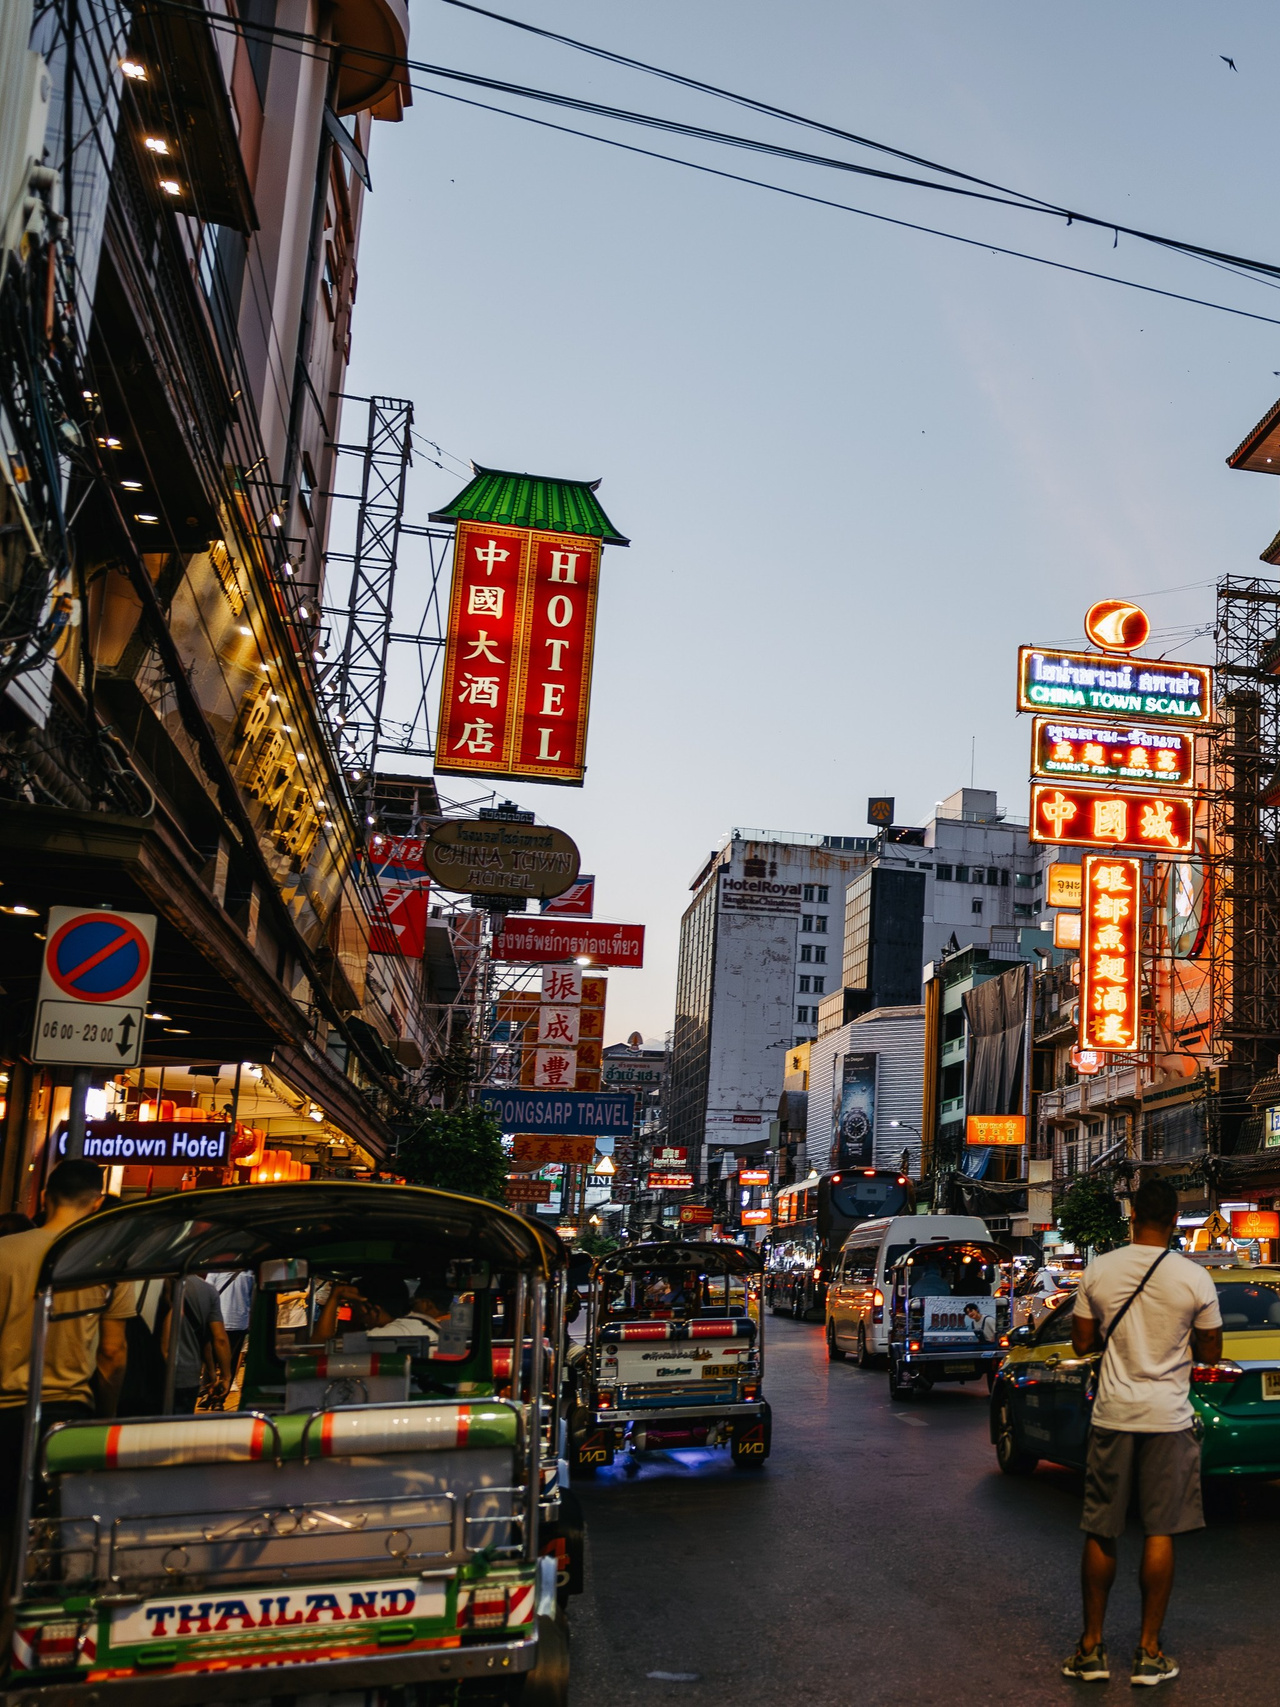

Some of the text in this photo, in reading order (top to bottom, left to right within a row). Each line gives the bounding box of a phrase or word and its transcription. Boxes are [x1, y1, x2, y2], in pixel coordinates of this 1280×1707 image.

[453, 540, 511, 754] 中國大酒店
[536, 551, 581, 761] HOTEL
[1030, 685, 1202, 717] CHINA TOWN SCALA
[1155, 771, 1181, 780] NEST
[1042, 791, 1179, 847] 中國城
[433, 844, 505, 868] CHINA
[512, 850, 573, 874] TOWN
[468, 870, 535, 890] HOTEL
[578, 1102, 629, 1126] TRAVEL
[59, 1131, 225, 1158] Cinatown Hotel
[931, 1313, 966, 1328] BOOK
[145, 1587, 416, 1637] THAILAND
